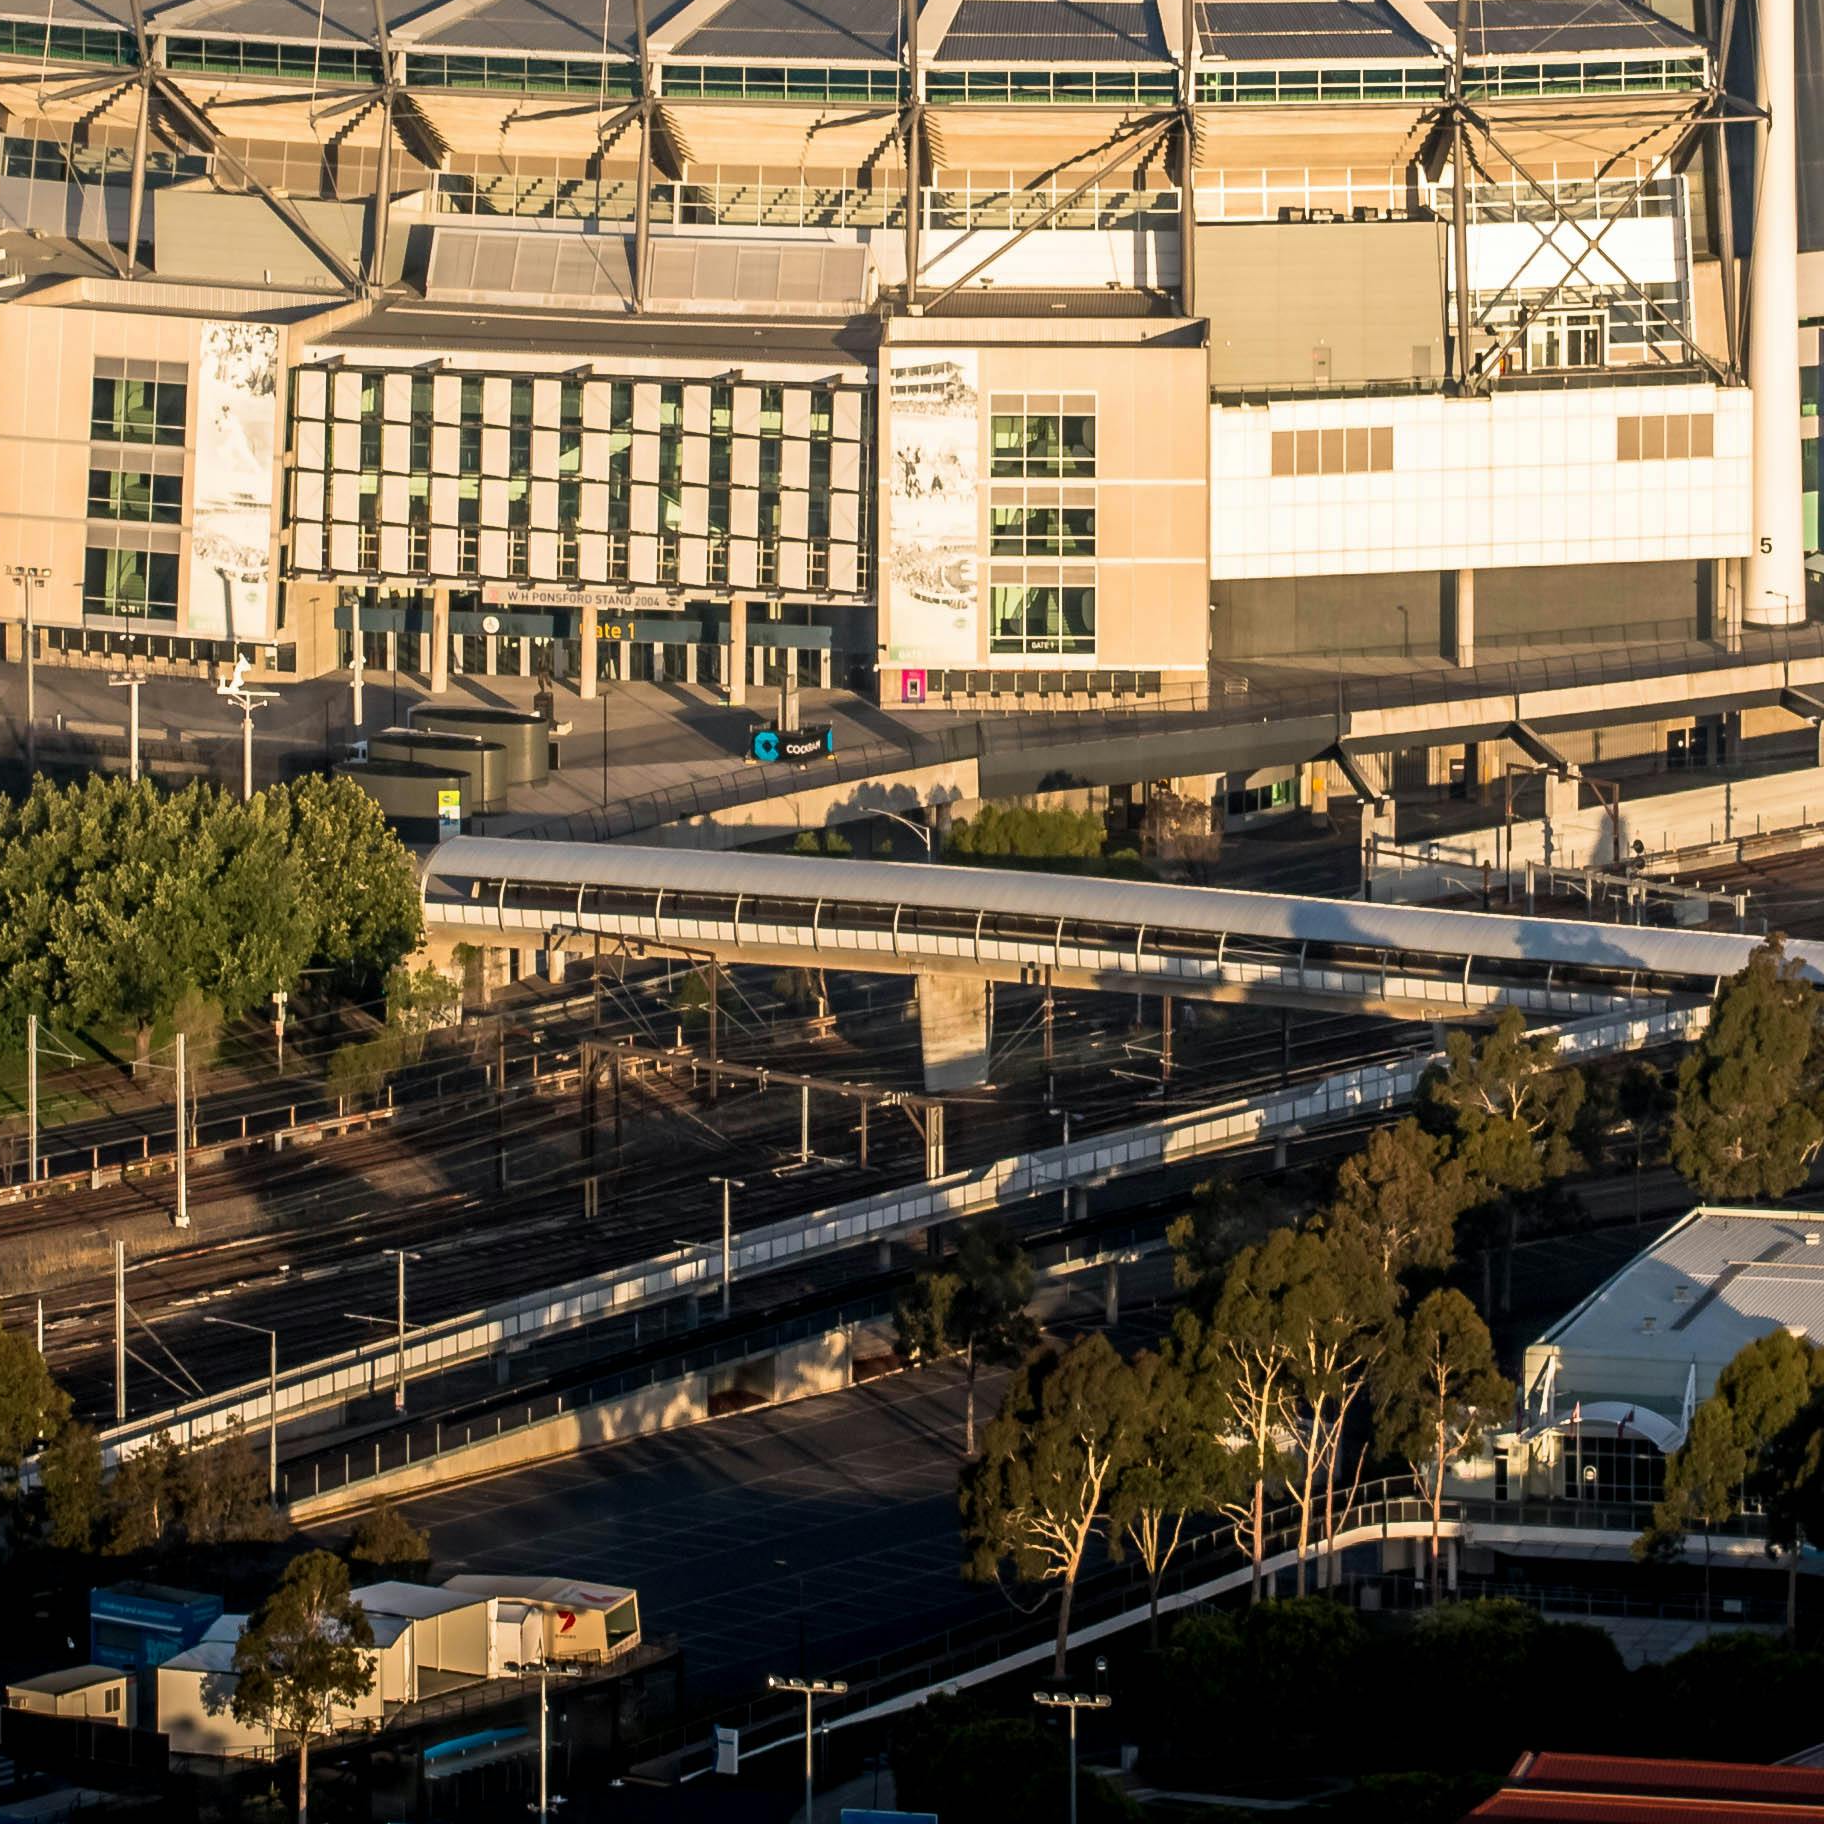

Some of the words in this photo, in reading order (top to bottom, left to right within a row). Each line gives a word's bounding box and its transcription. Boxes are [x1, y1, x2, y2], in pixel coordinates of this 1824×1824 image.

[1760, 537, 1773, 554] 5
[507, 591, 519, 601] W
[521, 592, 529, 601] H
[532, 592, 592, 604] PONSFORD
[595, 594, 631, 605] STAND
[635, 597, 660, 607] 2004
[627, 622, 634, 640] 1
[1031, 641, 1048, 650] GATE
